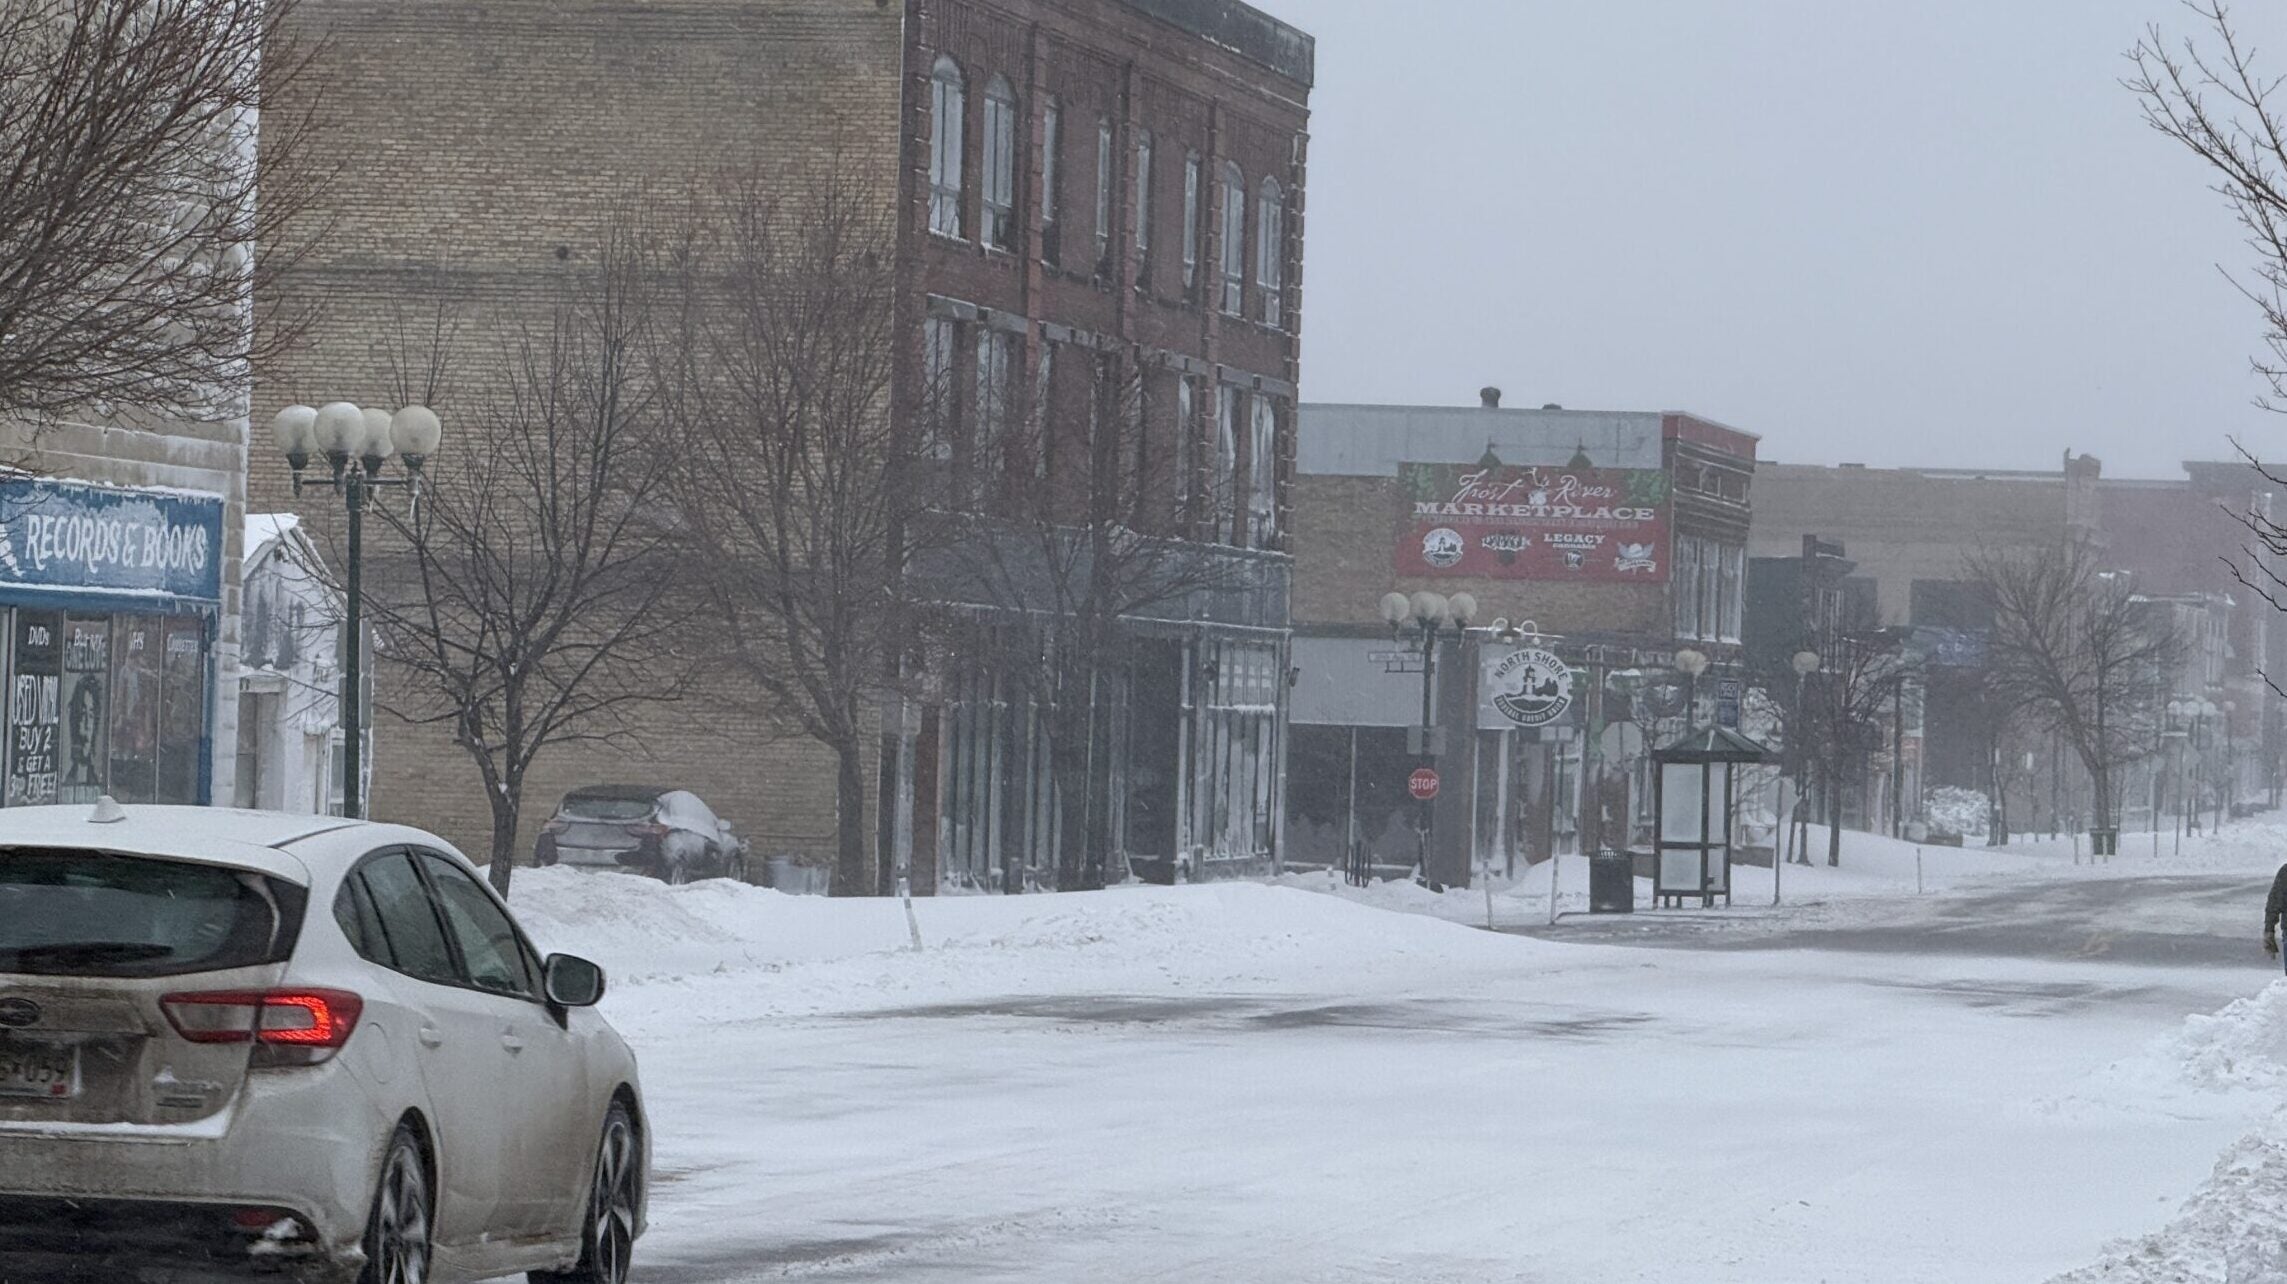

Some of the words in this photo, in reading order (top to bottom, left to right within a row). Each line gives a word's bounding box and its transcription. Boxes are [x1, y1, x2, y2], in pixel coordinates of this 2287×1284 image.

[1451, 468, 1523, 503] Frost
[1553, 475, 1617, 507] River
[1414, 502, 1655, 520] MARKETPLACE
[25, 514, 121, 574] RECORDS
[122, 523, 138, 568] &
[140, 521, 207, 575] BOOKS
[1543, 533, 1606, 544] LEGACY
[28, 626, 50, 646] DVDs
[1494, 651, 1530, 679] NORTH
[1534, 651, 1568, 680] SHORE
[13, 673, 36, 725] USED
[19, 726, 42, 755] BUY
[43, 726, 52, 752] 2
[26, 755, 44, 773] GET
[43, 755, 51, 771] A
[27, 770, 58, 799] FREE!
[1411, 778, 1437, 790] STOP
